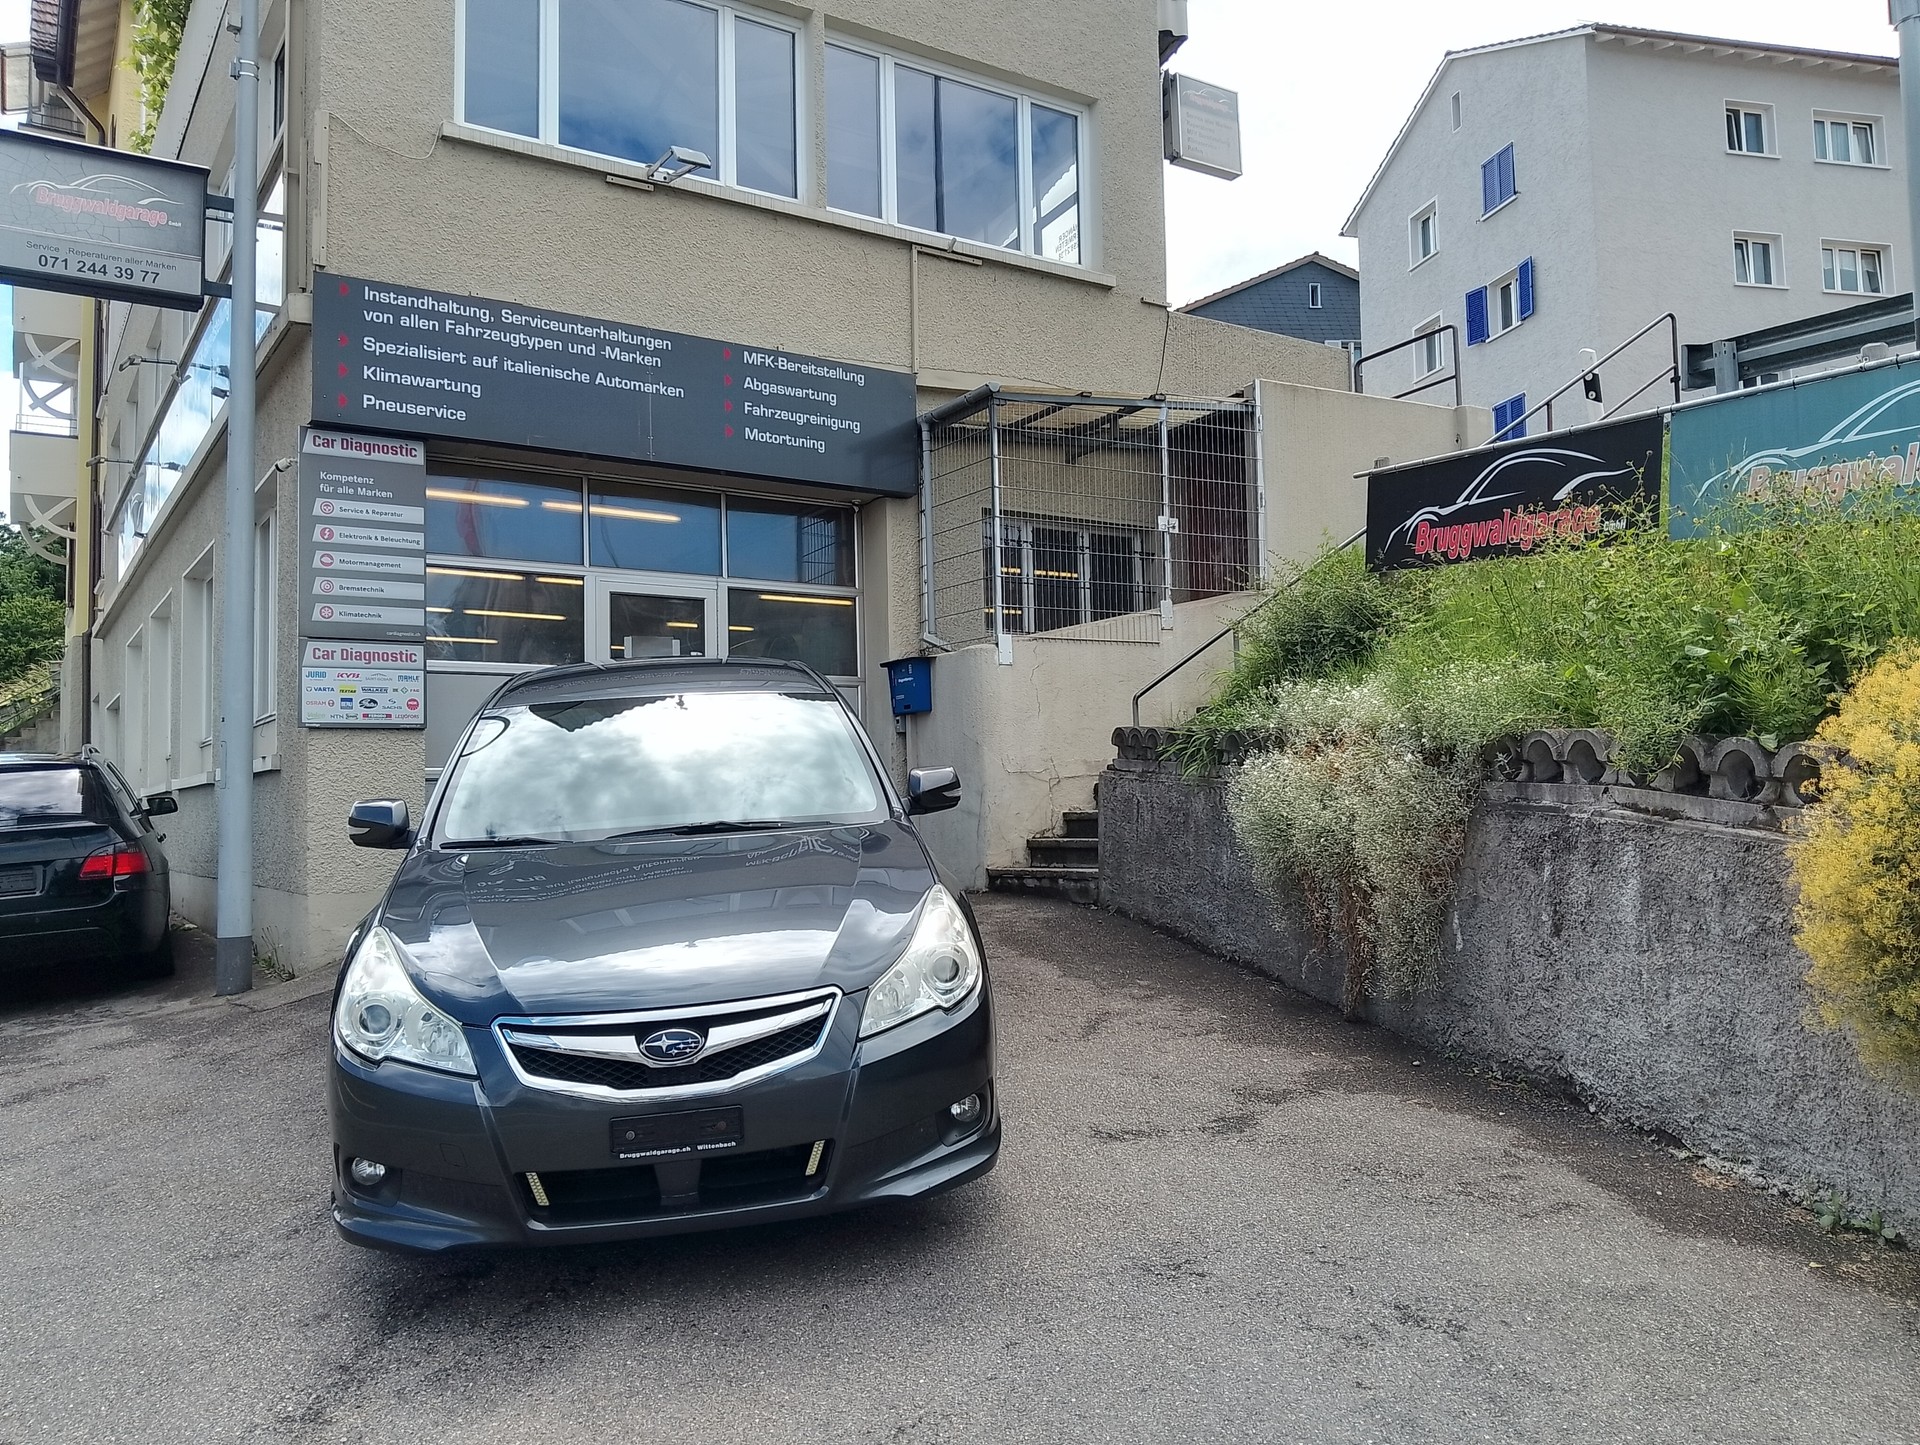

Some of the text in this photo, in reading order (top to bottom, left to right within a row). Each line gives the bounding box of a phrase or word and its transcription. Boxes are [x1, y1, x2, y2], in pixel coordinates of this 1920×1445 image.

[35, 186, 168, 228] Bruggwaldgarage
[26, 240, 60, 253] Service
[125, 256, 144, 265] aller
[145, 260, 177, 271] Marken
[38, 254, 160, 284] 071 244 39 77
[364, 286, 672, 351] Instandhaltung, Serviceunterhaltungen
[363, 309, 661, 368] von allen Fahrzeugtypen und -Marken
[363, 336, 684, 398] Spezialisiert auf italienische Automarken
[743, 350, 865, 387] MFK-Bereitstellung
[363, 365, 481, 399] Klimawartung
[743, 376, 837, 405] Abgaswartung
[363, 394, 467, 421] Pneuservice
[744, 402, 861, 434] Fahrzeugreinigung
[312, 434, 418, 458] Car Diagnostic
[744, 427, 825, 454] Motortuning
[319, 484, 393, 498] für alle Marken
[320, 471, 375, 485] Kompetenz
[339, 506, 364, 515] Service
[371, 509, 404, 518] Reparatur
[339, 532, 372, 541] Elektronik
[380, 535, 421, 546] Beleuchtung
[339, 558, 402, 569] Motormanagement
[339, 584, 385, 593] Bremstechnik
[339, 610, 382, 619] Klimatechnik
[312, 647, 418, 665] Car Diagnostic
[306, 671, 327, 679] JURID
[619, 1141, 736, 1159] Bruggwaldgarage.ch Wittenbach
